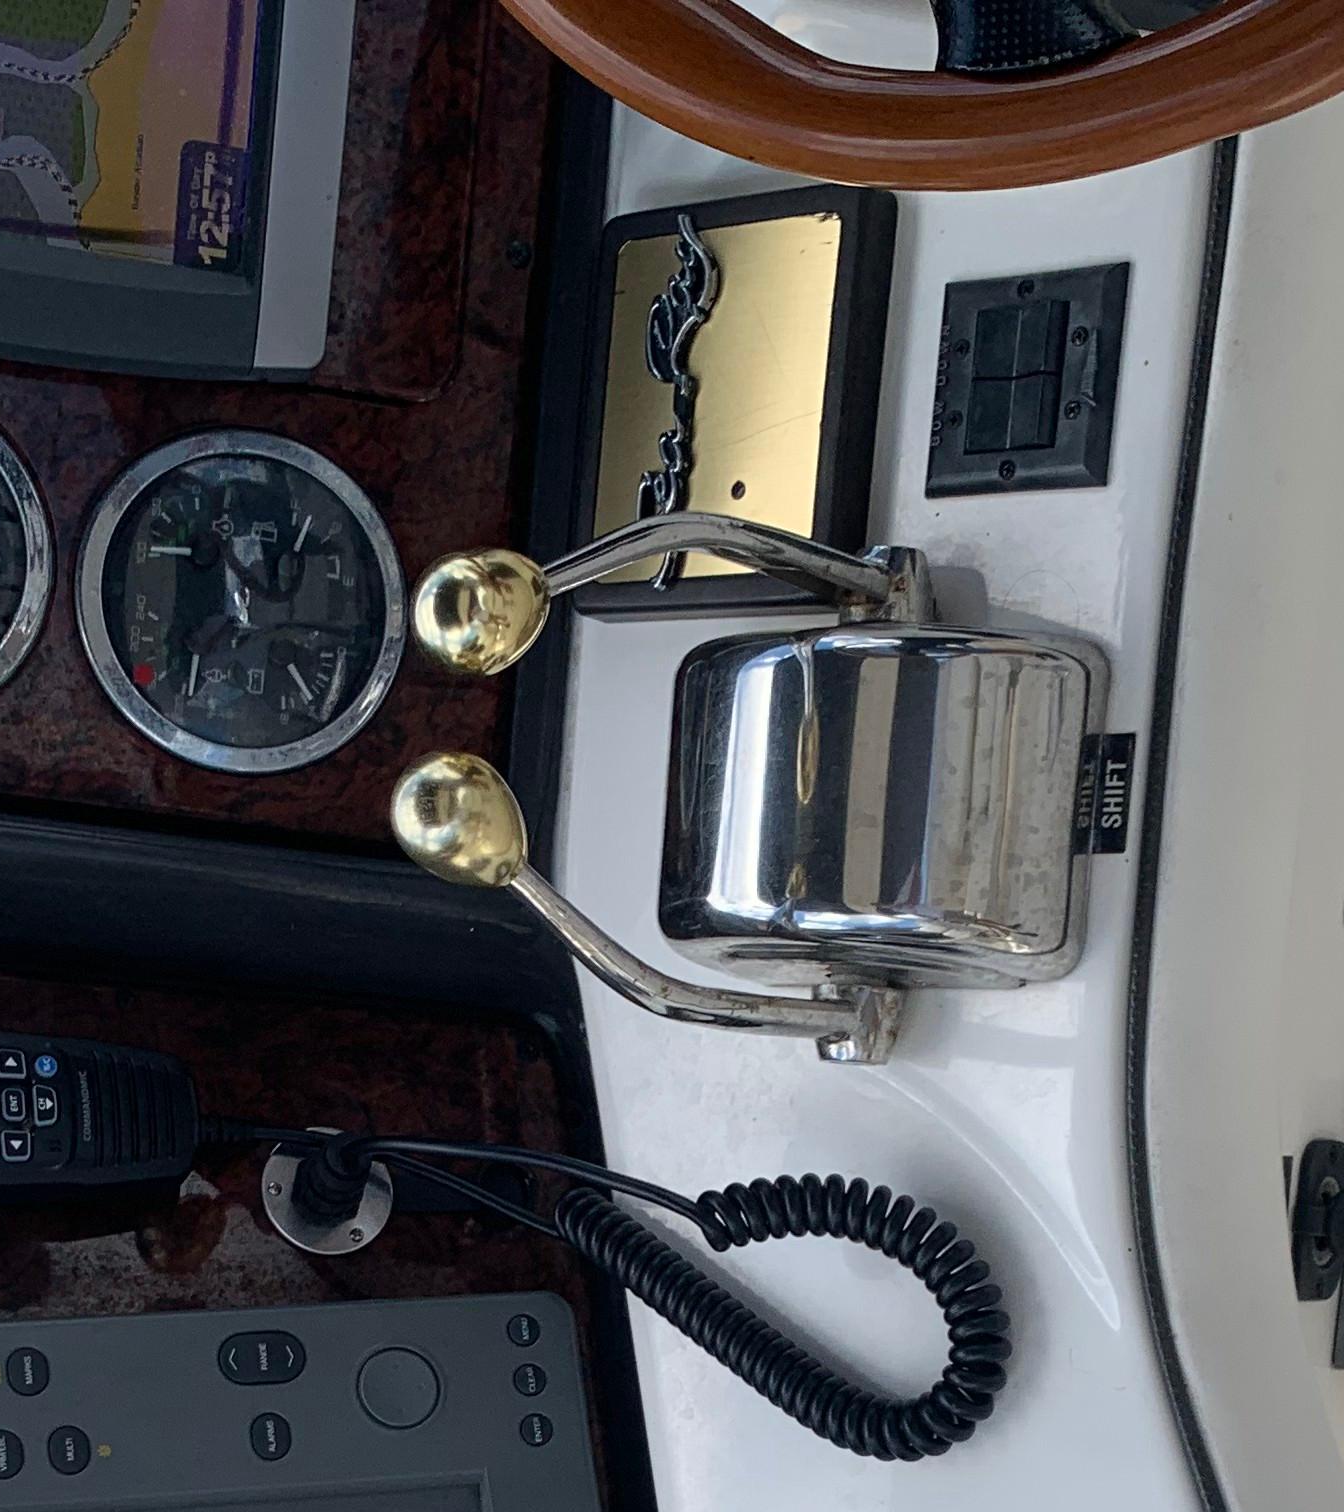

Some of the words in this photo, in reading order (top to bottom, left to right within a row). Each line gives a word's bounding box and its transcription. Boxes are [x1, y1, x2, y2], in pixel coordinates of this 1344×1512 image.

[1100, 760, 1127, 829] SHIFT
[9, 1095, 19, 1113] ENT
[37, 1097, 46, 1111] CH
[77, 1070, 92, 1143] COMMANDMIC
[520, 1317, 530, 1341] MENU
[22, 1355, 33, 1385] MARKS
[258, 1343, 268, 1371] RANGE
[526, 1367, 536, 1393] CLEAR
[266, 1420, 276, 1452] ALARMS
[532, 1416, 543, 1443] ENTER
[65, 1437, 75, 1461] MULTI
